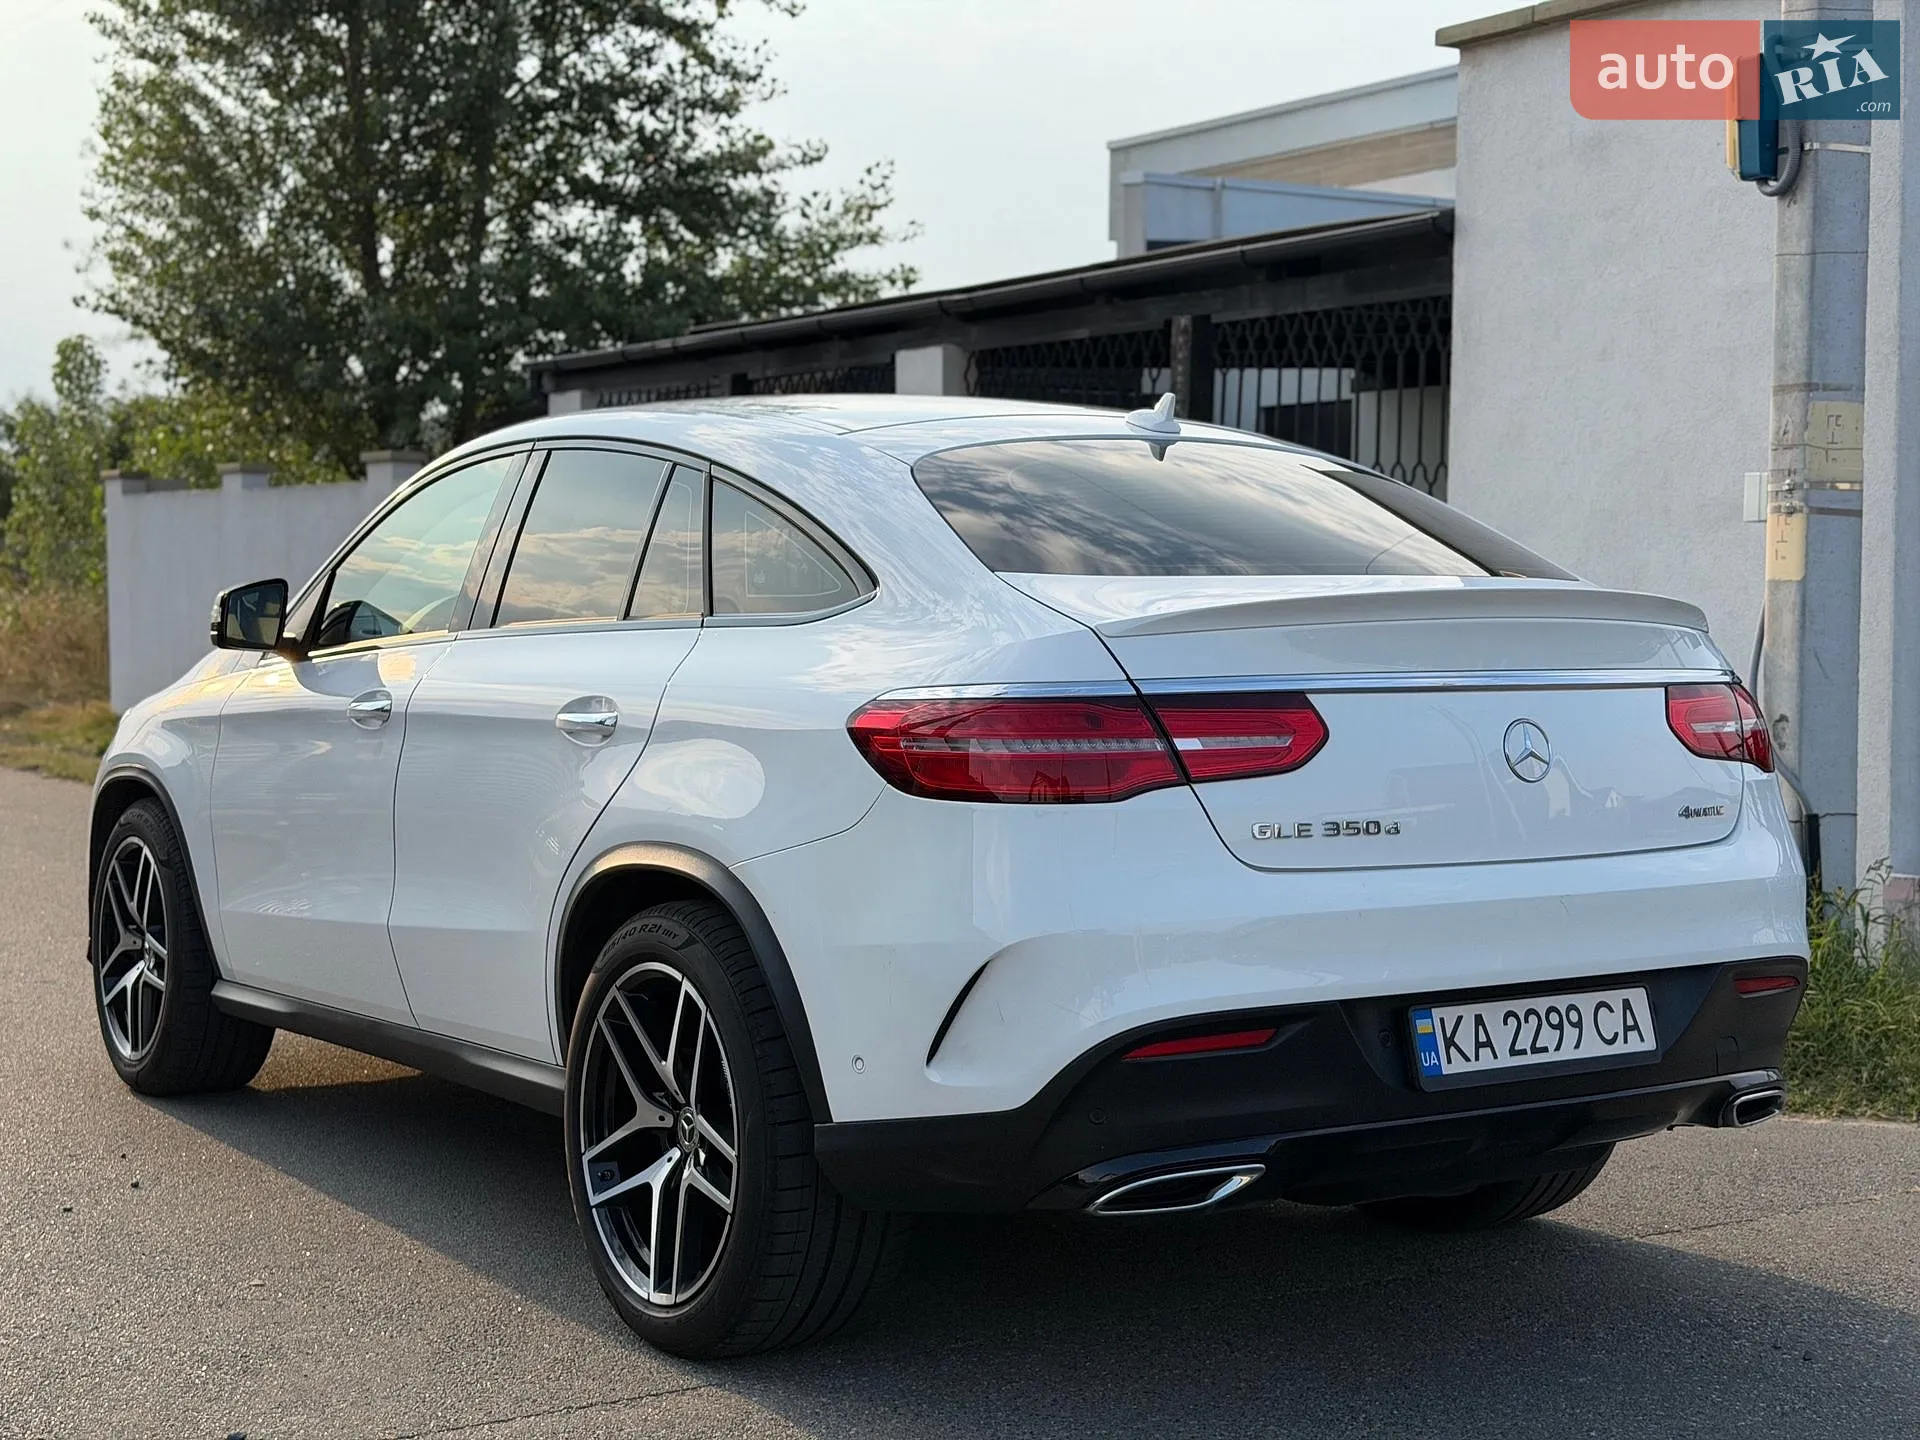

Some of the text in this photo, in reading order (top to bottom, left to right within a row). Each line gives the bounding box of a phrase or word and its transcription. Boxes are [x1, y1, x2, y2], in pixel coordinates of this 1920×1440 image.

[1252, 822, 1313, 840] GLE
[638, 923, 662, 934] R21
[1439, 998, 1645, 1064] KA 2299 CA
[1423, 1051, 1439, 1066] UA
